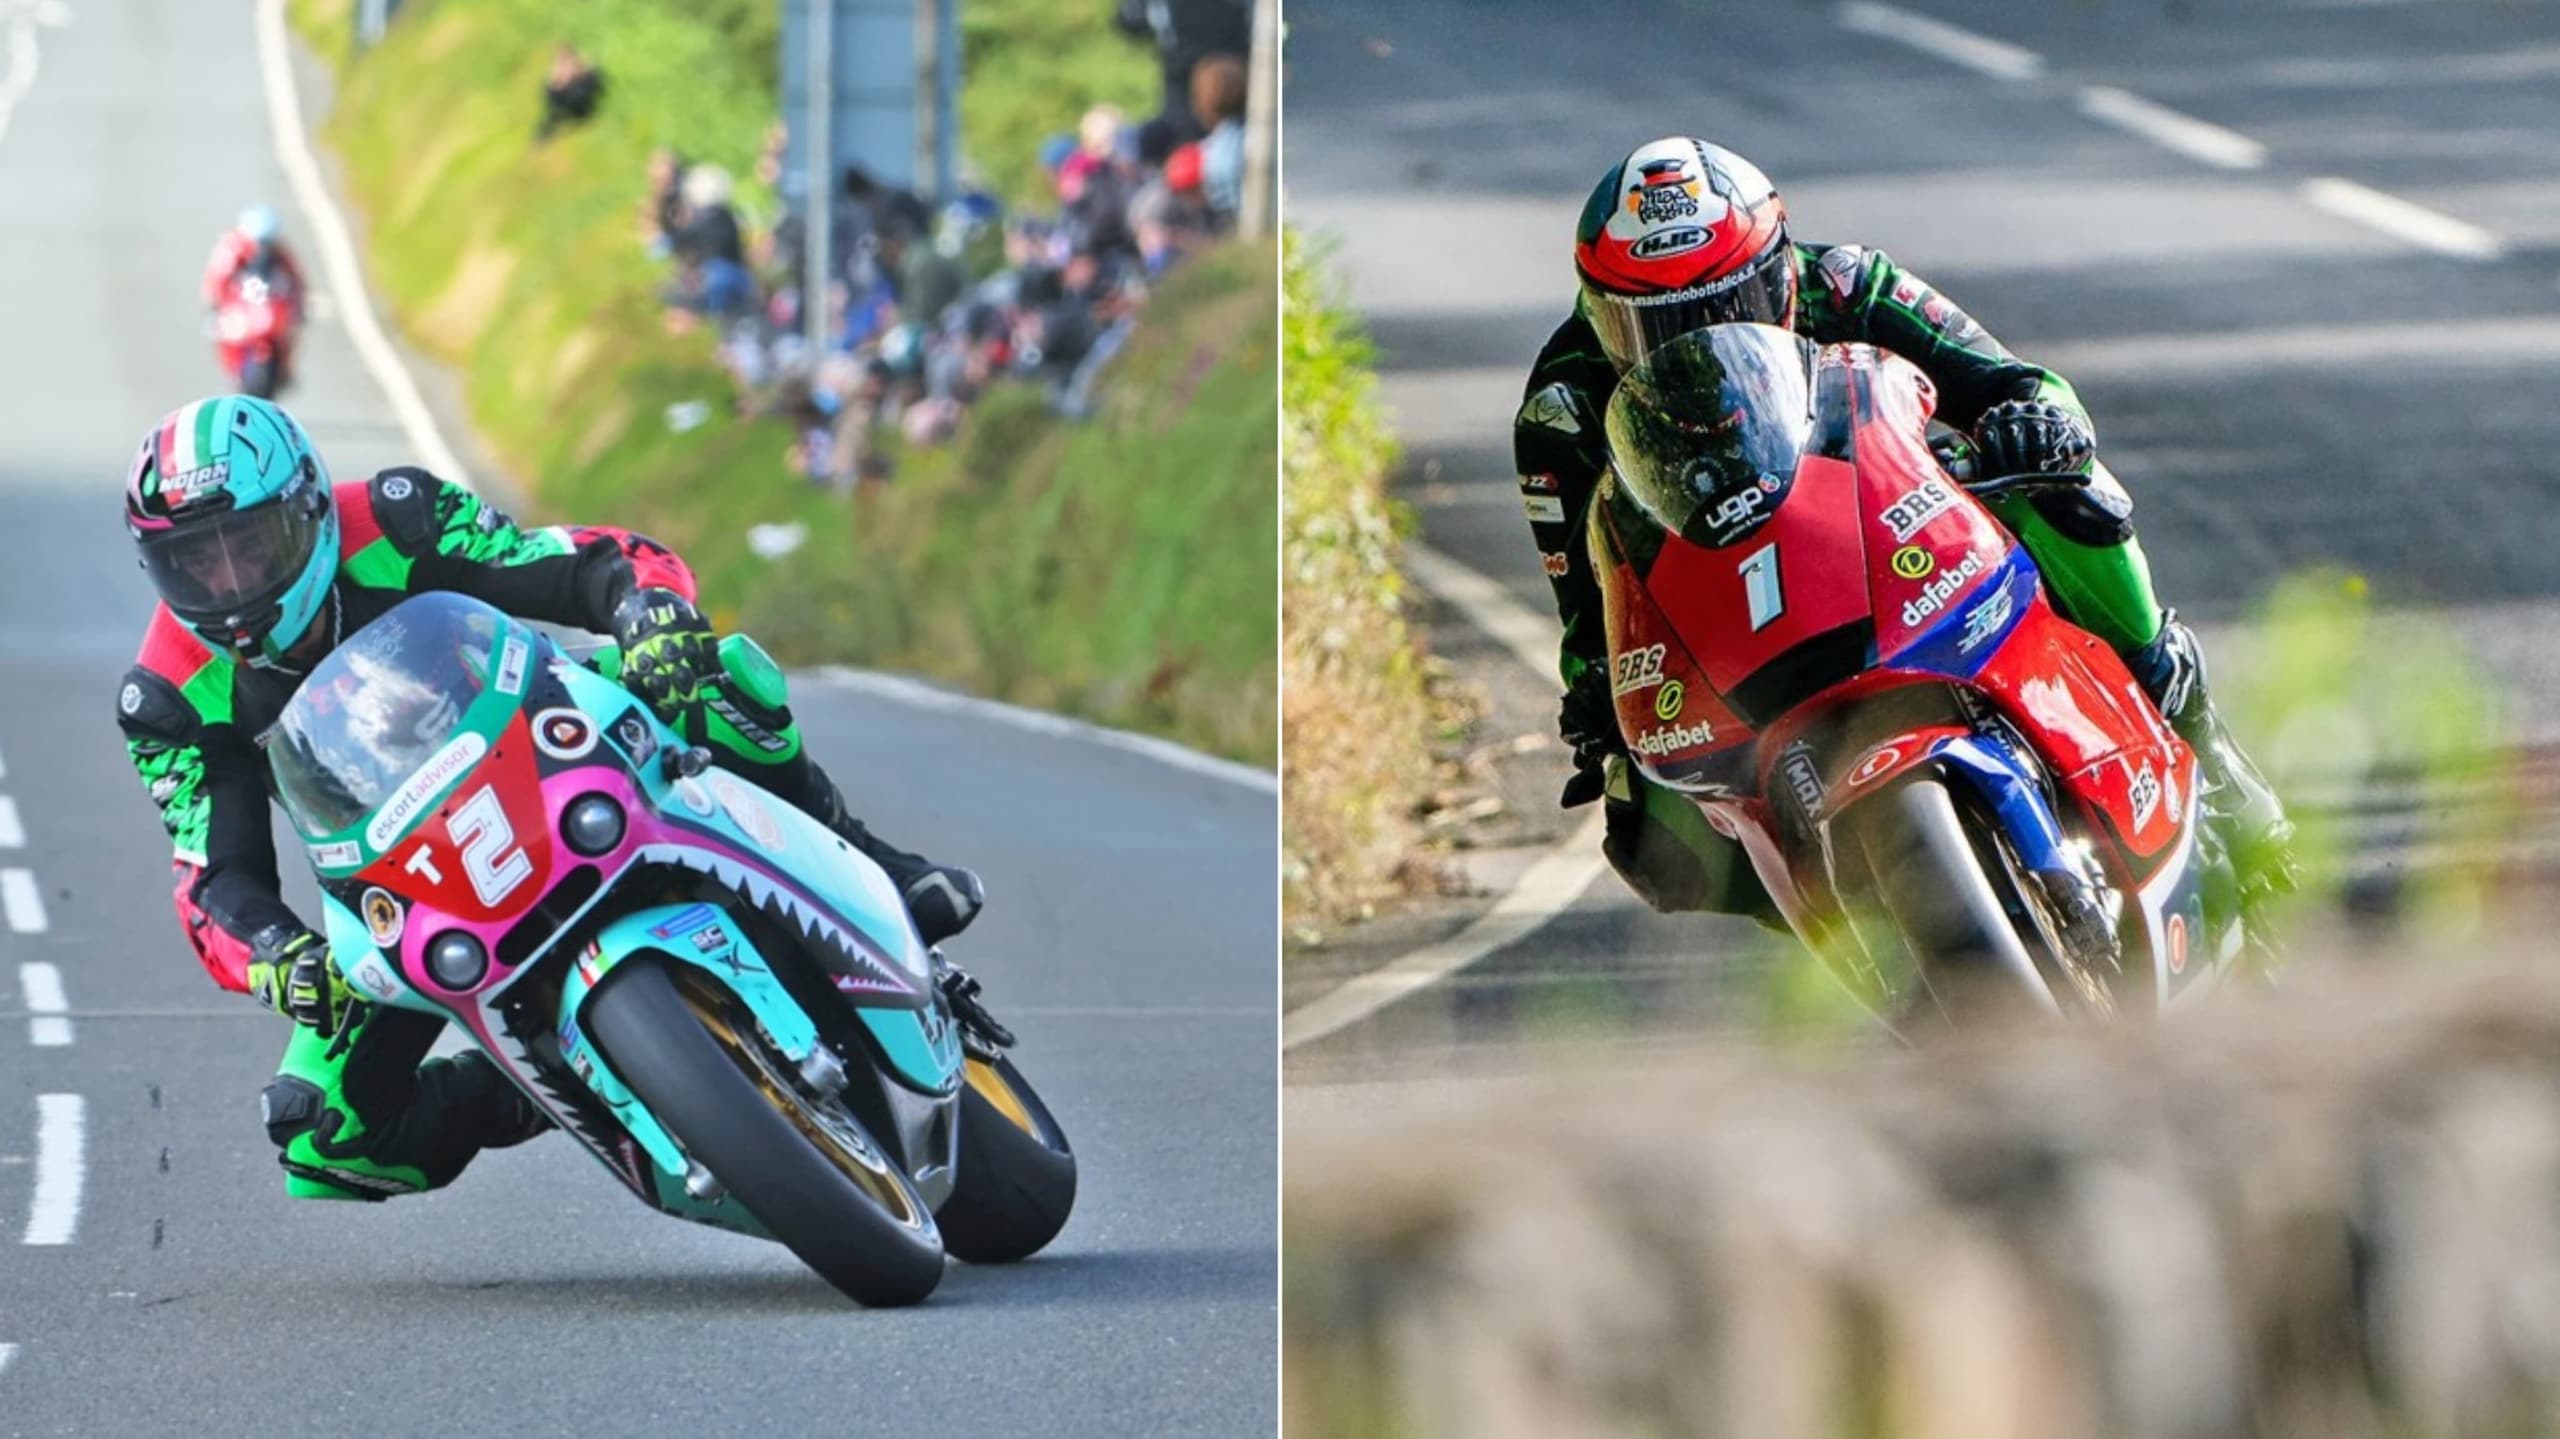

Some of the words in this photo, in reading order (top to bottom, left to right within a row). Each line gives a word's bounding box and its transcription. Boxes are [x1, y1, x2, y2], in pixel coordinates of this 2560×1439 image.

[1640, 230, 1700, 253] HJC
[159, 463, 230, 493] NOLAN
[1705, 486, 1764, 529] ugp
[1885, 482, 1947, 531] BRS
[1738, 542, 1784, 632] 1
[1902, 549, 1984, 627] dafabet
[1638, 719, 1715, 757] dafabet
[375, 745, 470, 841] escortadvisor
[404, 843, 444, 886] T
[445, 783, 535, 909] 2
